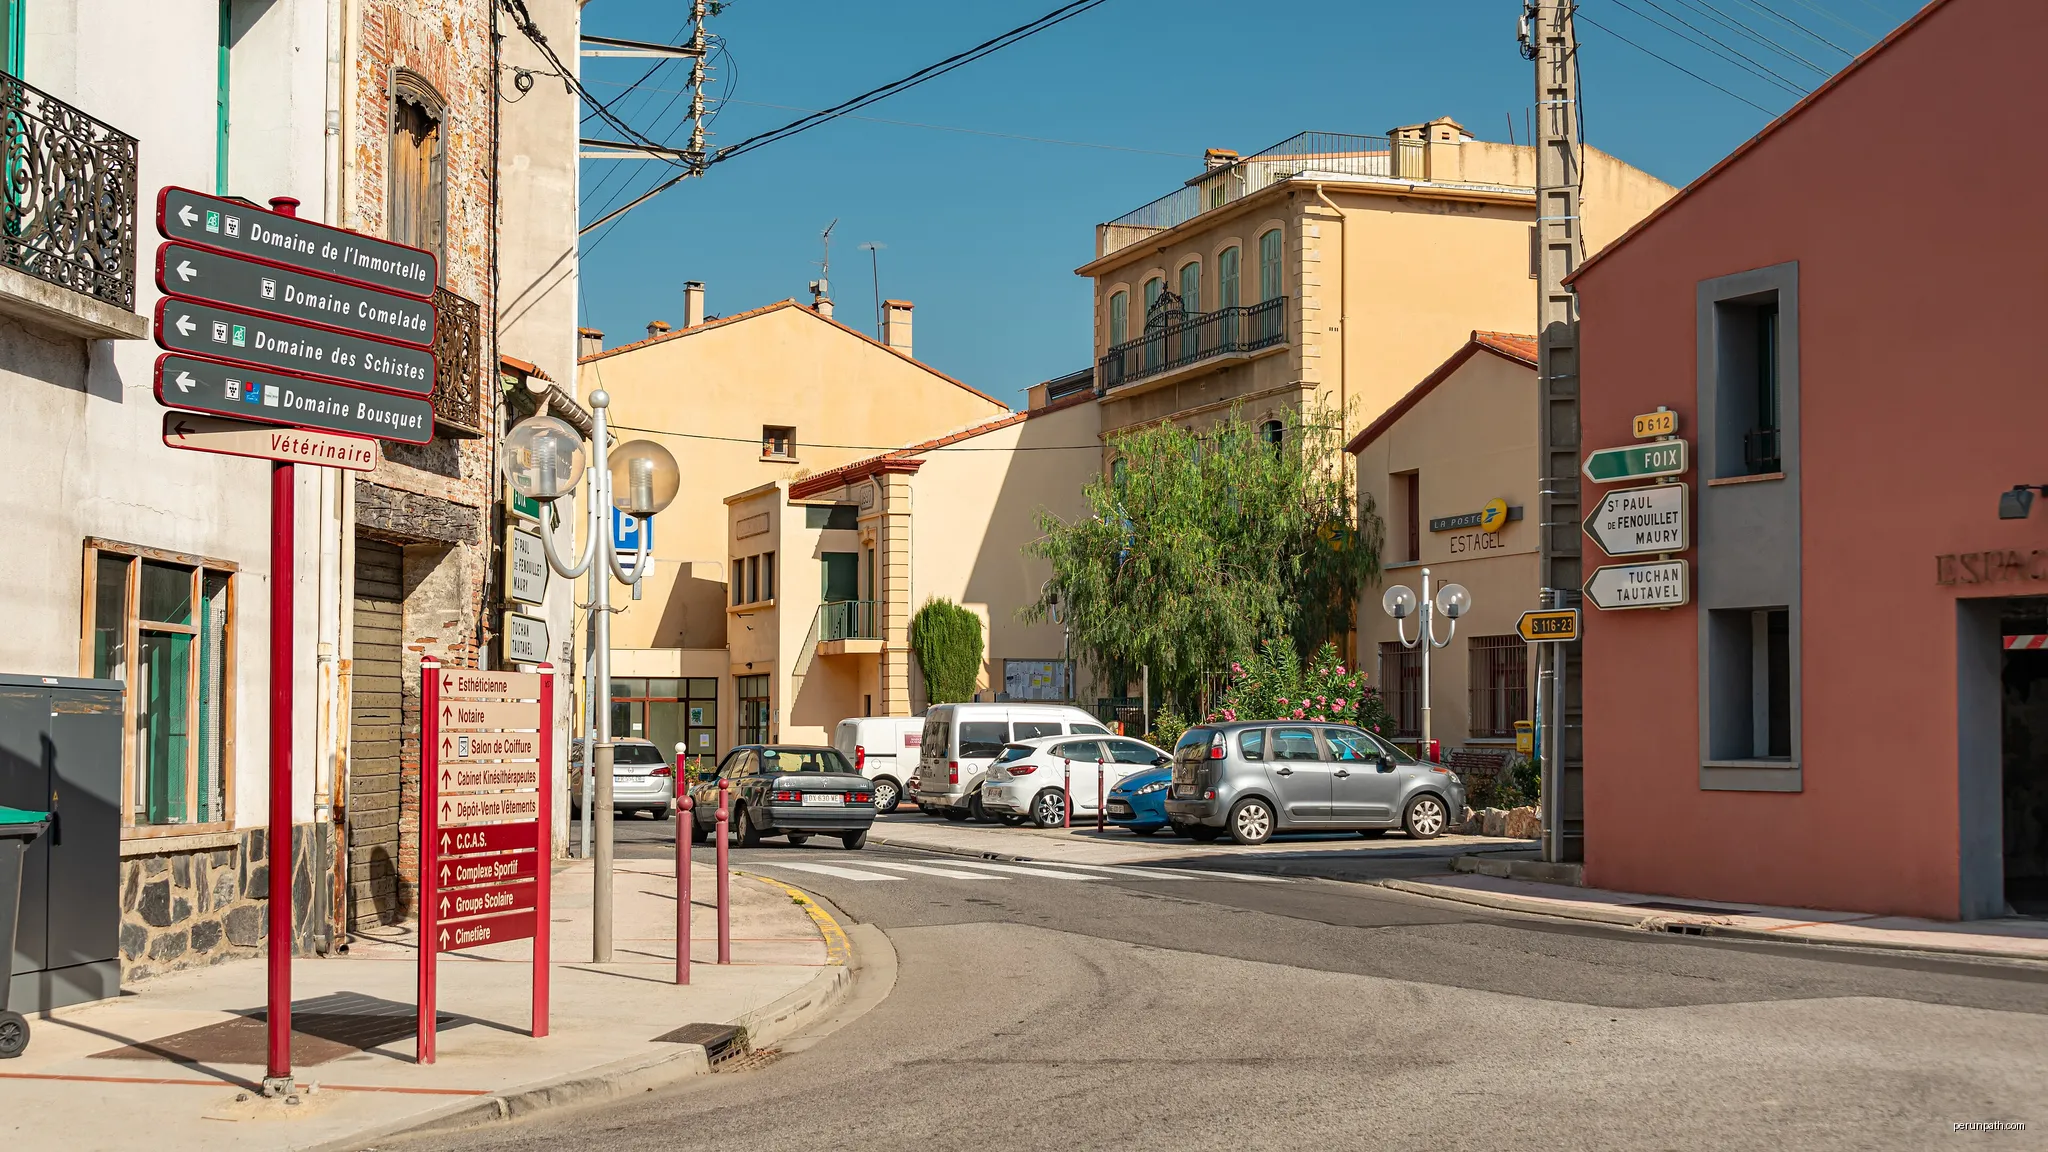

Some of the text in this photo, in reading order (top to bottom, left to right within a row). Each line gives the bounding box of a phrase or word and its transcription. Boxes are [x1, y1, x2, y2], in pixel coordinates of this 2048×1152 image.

[250, 223, 427, 282] Domaine de l'Immortelle
[284, 285, 427, 332] Domaine Comelade
[255, 331, 425, 381] Domaine des Schistes
[284, 390, 349, 418] Domaine
[357, 402, 423, 431] Bousquet
[1637, 417, 1670, 433] D 612
[270, 433, 371, 463] Vétérinaire
[1644, 450, 1677, 469] FOIX
[1624, 496, 1652, 511] PAUL
[619, 511, 639, 542] P
[1434, 515, 1482, 529] LA POSTE
[1618, 511, 1678, 530] FENOUILLET
[1450, 531, 1505, 554] ESTAGEL
[1636, 529, 1678, 545] MAURY
[1629, 568, 1679, 584] TUCHAN
[1617, 584, 1679, 601] TAUTAVEL
[1533, 618, 1574, 632] S 116-23
[458, 677, 508, 693] Esthéticienne
[458, 708, 485, 723] Notaire
[471, 739, 532, 755] Salon de Coiffure
[457, 768, 536, 787] Cabinet Kinésithérapeutes
[457, 798, 536, 820] Dépôt-Vente Vêtements
[456, 832, 487, 849] C.C.A.S.
[456, 859, 518, 883] Complexe Sportif
[456, 891, 514, 914] Groupe Scolaire
[455, 925, 491, 944] Cimetière
